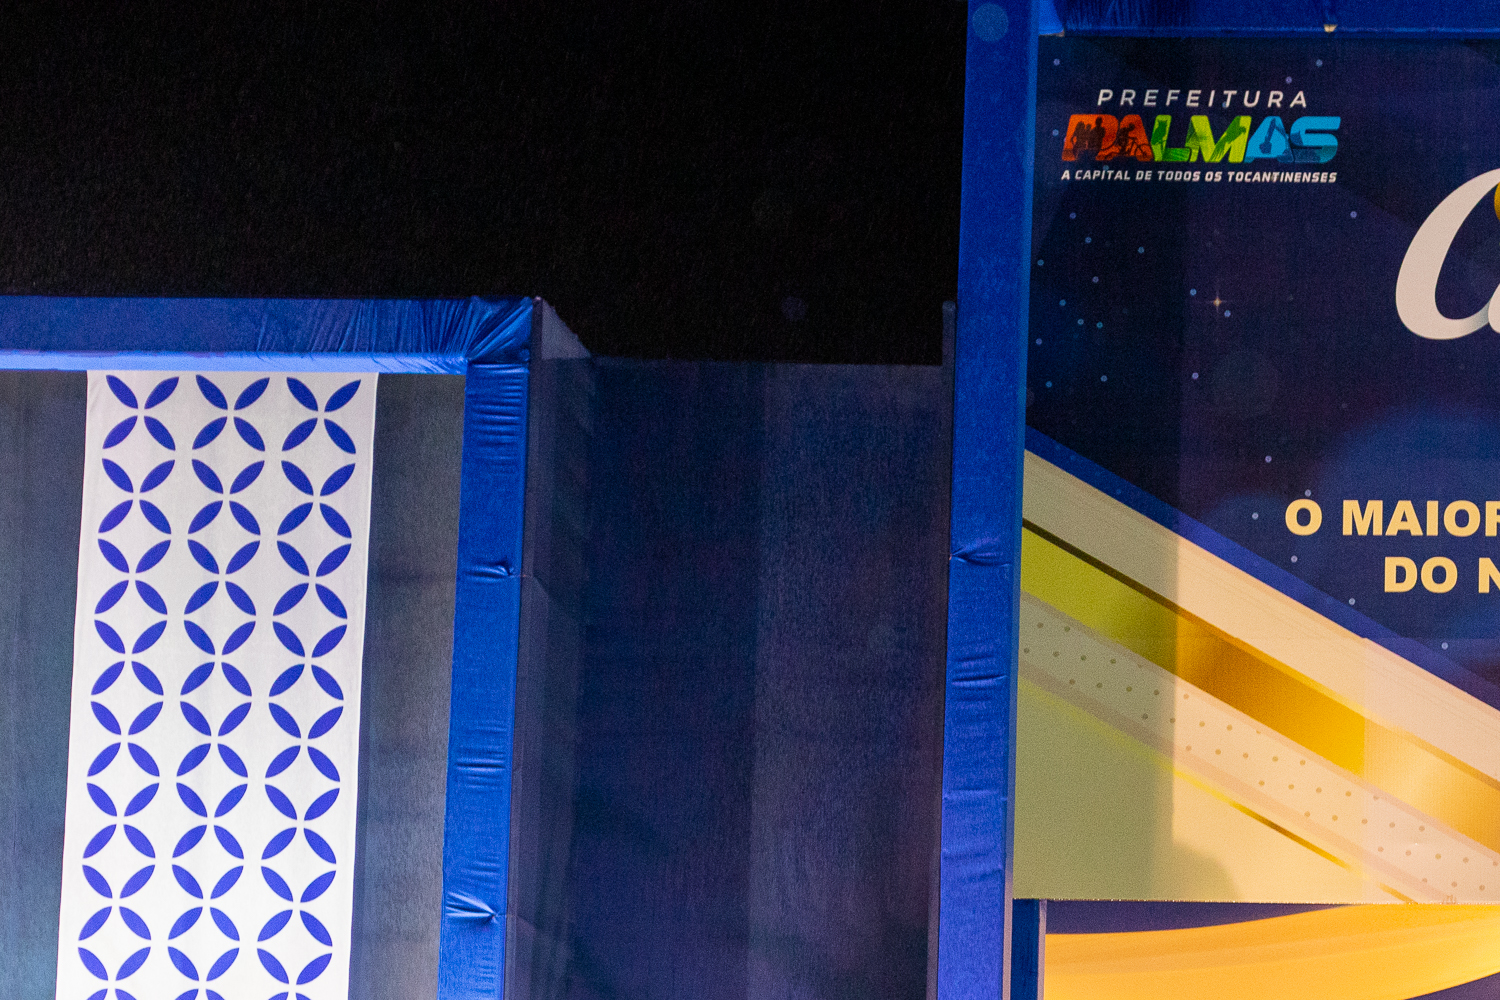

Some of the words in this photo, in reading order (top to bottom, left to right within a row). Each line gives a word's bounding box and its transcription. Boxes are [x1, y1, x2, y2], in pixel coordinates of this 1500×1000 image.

[1097, 89, 1306, 108] PREFEITURA
[1061, 113, 1341, 163] PALMAS
[1061, 169, 1070, 180] A
[1074, 169, 1131, 181] CAPITAL
[1135, 170, 1152, 181] DE
[1157, 170, 1201, 182] TODOS
[1204, 171, 1223, 182] OS
[1227, 171, 1337, 183] TOCANTINENSES
[1284, 498, 1323, 536] O
[1384, 556, 1458, 594] DO
